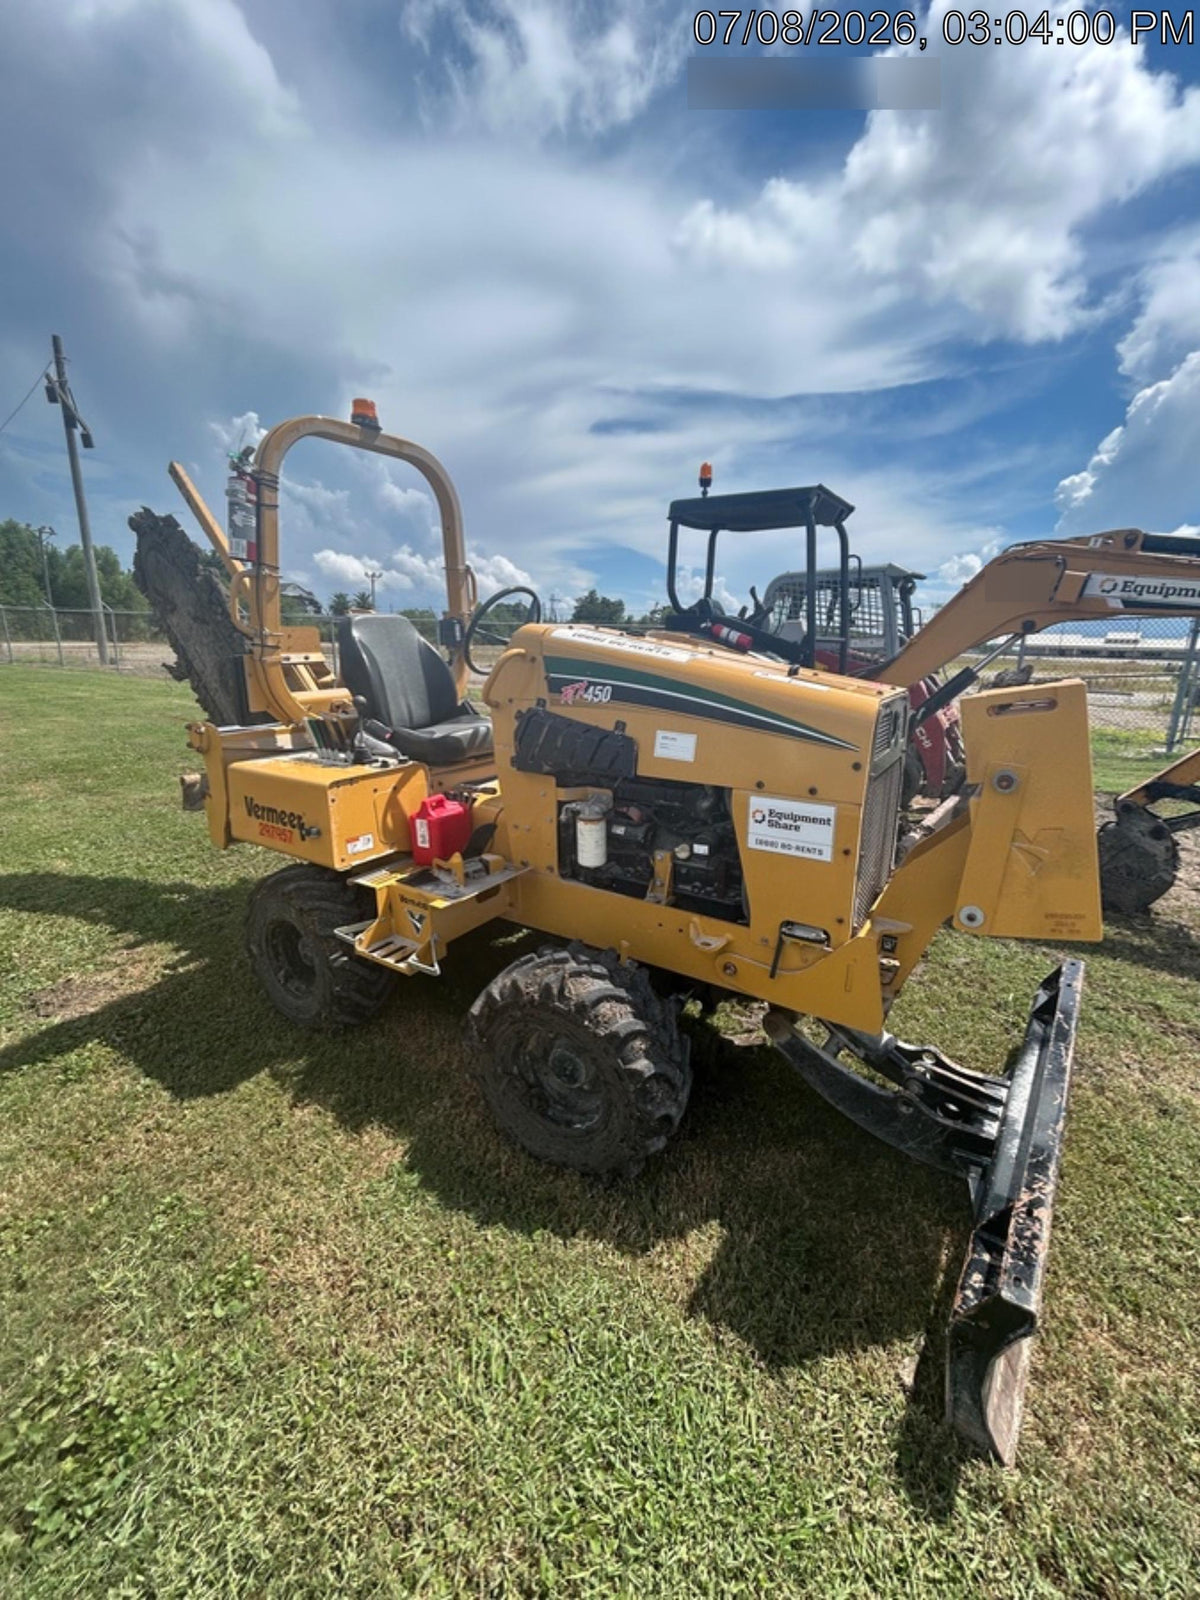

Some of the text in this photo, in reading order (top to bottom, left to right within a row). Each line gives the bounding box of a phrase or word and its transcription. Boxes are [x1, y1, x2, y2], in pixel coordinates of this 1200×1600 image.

[244, 796, 304, 832] Vermeer
[768, 808, 832, 827] Equipment
[767, 819, 801, 832] Share
